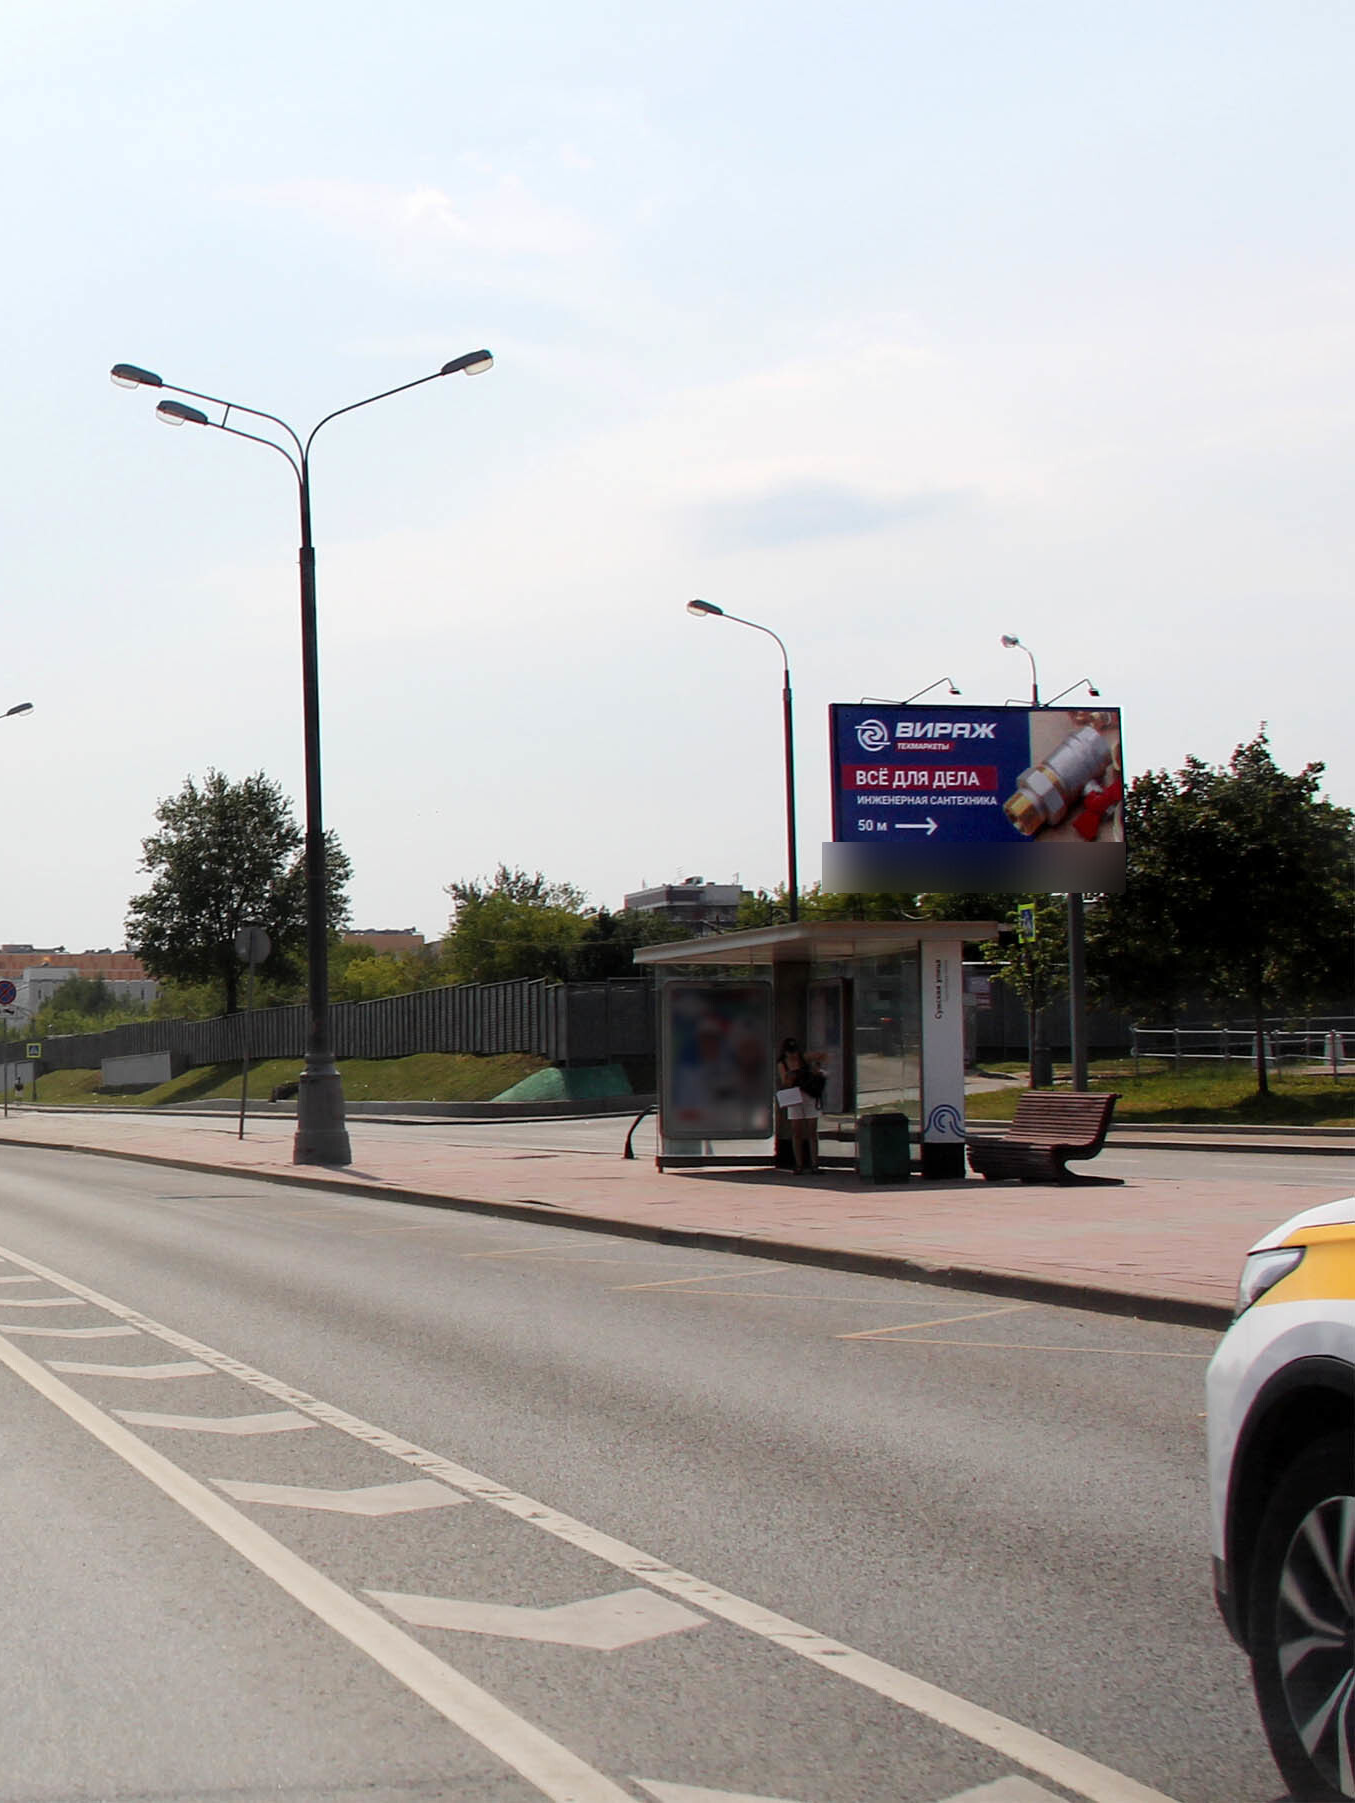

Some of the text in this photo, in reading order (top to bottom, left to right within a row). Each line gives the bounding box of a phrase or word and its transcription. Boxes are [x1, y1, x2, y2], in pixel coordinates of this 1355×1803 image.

[894, 722, 998, 739] ВИРАЖ
[897, 742, 950, 750] ТЕХМАРКЕТЫ
[855, 768, 980, 789] ВСЁ ДЛЯ ДЕЛА
[856, 795, 998, 806] ИНЖЕНЕРНАЯ САНТЕХНИКА
[857, 819, 874, 832] 50
